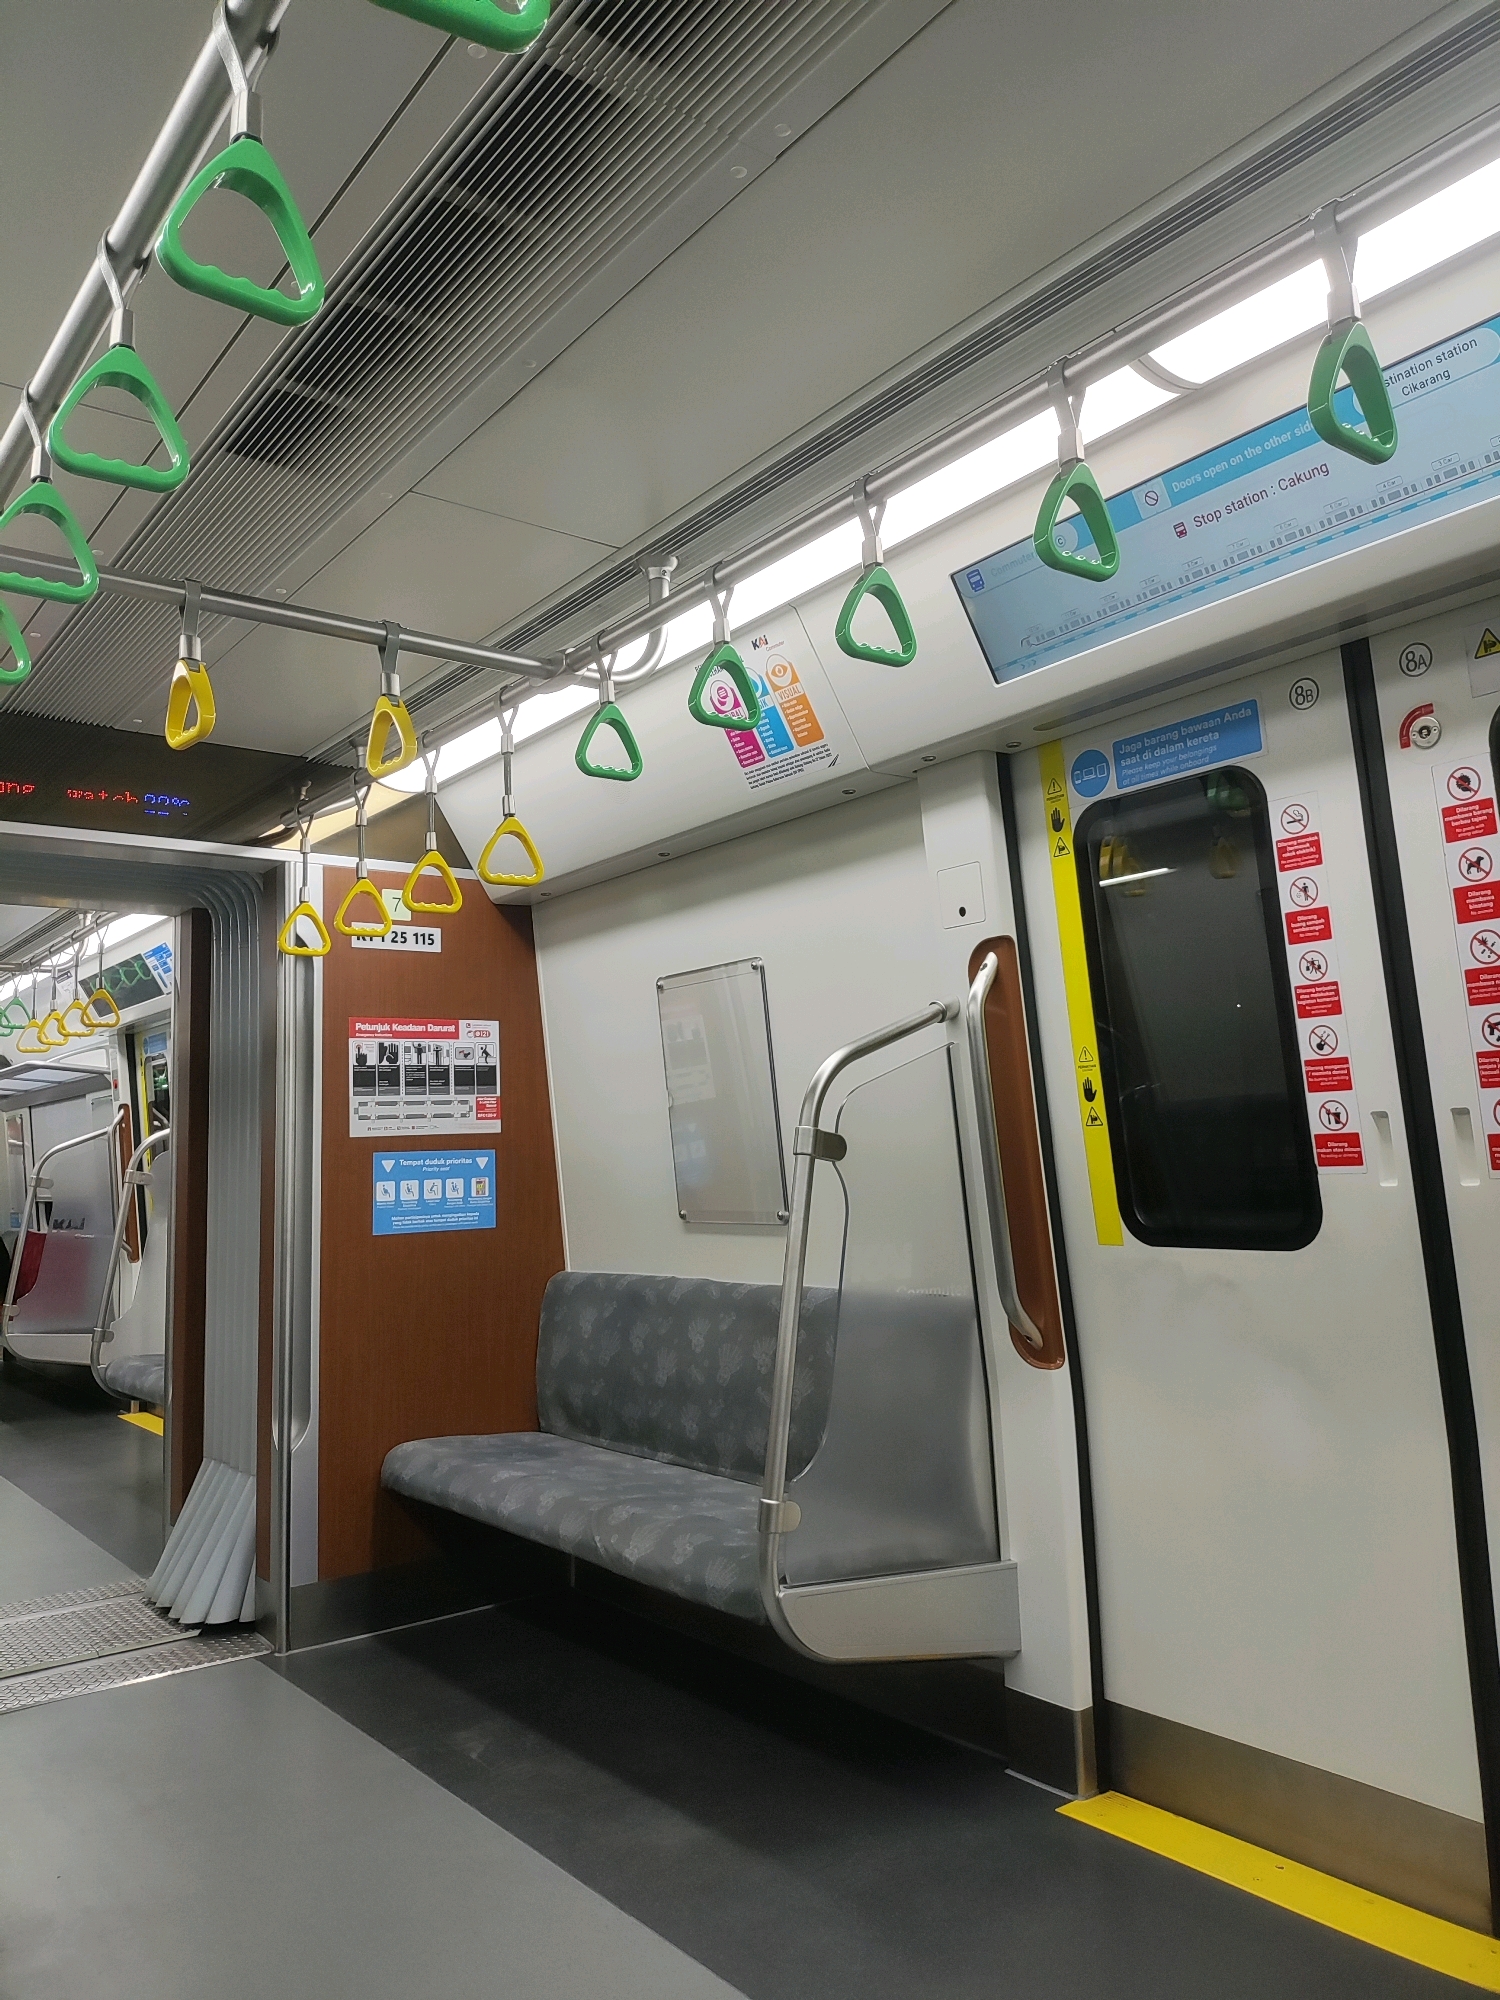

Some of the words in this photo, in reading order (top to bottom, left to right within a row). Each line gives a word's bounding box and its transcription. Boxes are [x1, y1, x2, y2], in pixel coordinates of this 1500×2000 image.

[1384, 359, 1433, 387] stination
[1435, 338, 1478, 364] station
[1401, 369, 1451, 396] Cikarang
[1171, 473, 1201, 492] Doors
[1203, 460, 1229, 478] open
[1229, 454, 1244, 466] on
[1244, 447, 1263, 459] the
[1264, 431, 1292, 451] other
[1193, 509, 1222, 528] Stop
[1224, 488, 1269, 515] station
[1277, 463, 1330, 491] Cakung
[991, 551, 1036, 577] Commuter
[1405, 650, 1427, 672] 8A
[778, 685, 802, 701] VISUAL
[1295, 685, 1314, 705] 8B
[1119, 741, 1142, 754] Jaga
[1144, 730, 1179, 747] barang
[1180, 716, 1221, 736] bawaan
[1223, 707, 1252, 723] Anda
[1120, 755, 1140, 767] saat
[1142, 750, 1152, 761] di
[1154, 741, 1185, 757] dalam
[1186, 731, 1220, 747] kereta
[1121, 765, 1143, 777] Please
[1144, 760, 1161, 771] keep
[1162, 756, 1178, 767] your
[1178, 744, 1217, 761] belongings
[1141, 771, 1159, 781] times
[1160, 765, 1179, 776] while
[1180, 756, 1210, 769] onboard
[1456, 804, 1479, 813] Dilarang
[1473, 807, 1493, 816] barang
[1451, 818, 1471, 826] berbau
[1467, 889, 1492, 898] Dilarang
[392, 896, 402, 912] 7
[1296, 914, 1318, 922] Dilarang
[390, 930, 407, 944] 25
[413, 932, 435, 946] 115
[355, 1022, 390, 1032] Petunjuk
[392, 1023, 426, 1032] Keadaan
[427, 1023, 455, 1033] Darurat
[399, 1158, 424, 1167] Tempat
[446, 1158, 473, 1166] prioritas
